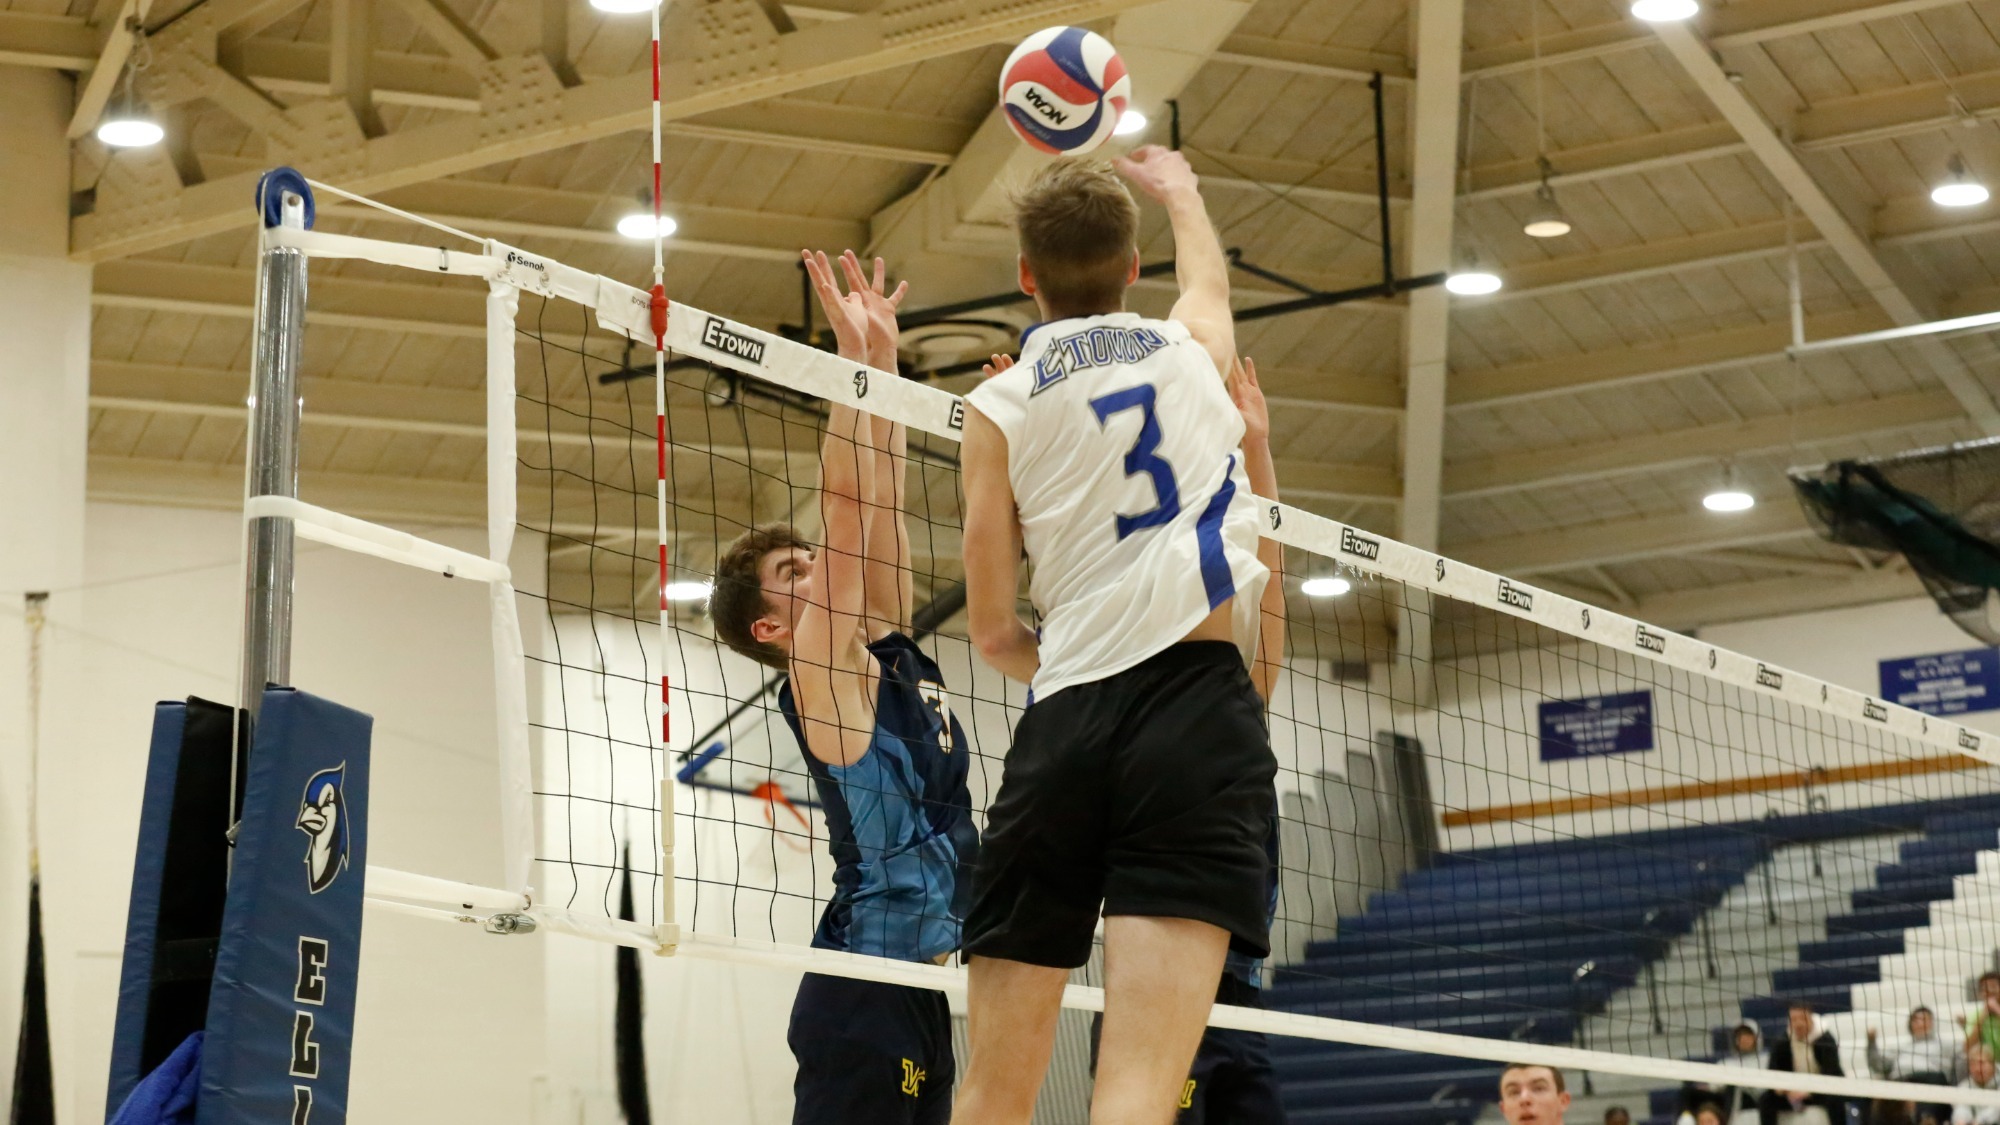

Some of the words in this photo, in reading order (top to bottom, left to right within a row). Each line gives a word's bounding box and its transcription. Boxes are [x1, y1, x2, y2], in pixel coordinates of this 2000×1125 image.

[1025, 87, 1068, 125] NCAA
[516, 256, 545, 272] Senoh
[703, 318, 763, 362] ETOWN
[1029, 327, 1169, 398] ETOWN
[1088, 383, 1181, 541] 3
[1342, 528, 1378, 559] ETOWN
[1499, 579, 1532, 610] ETOWN
